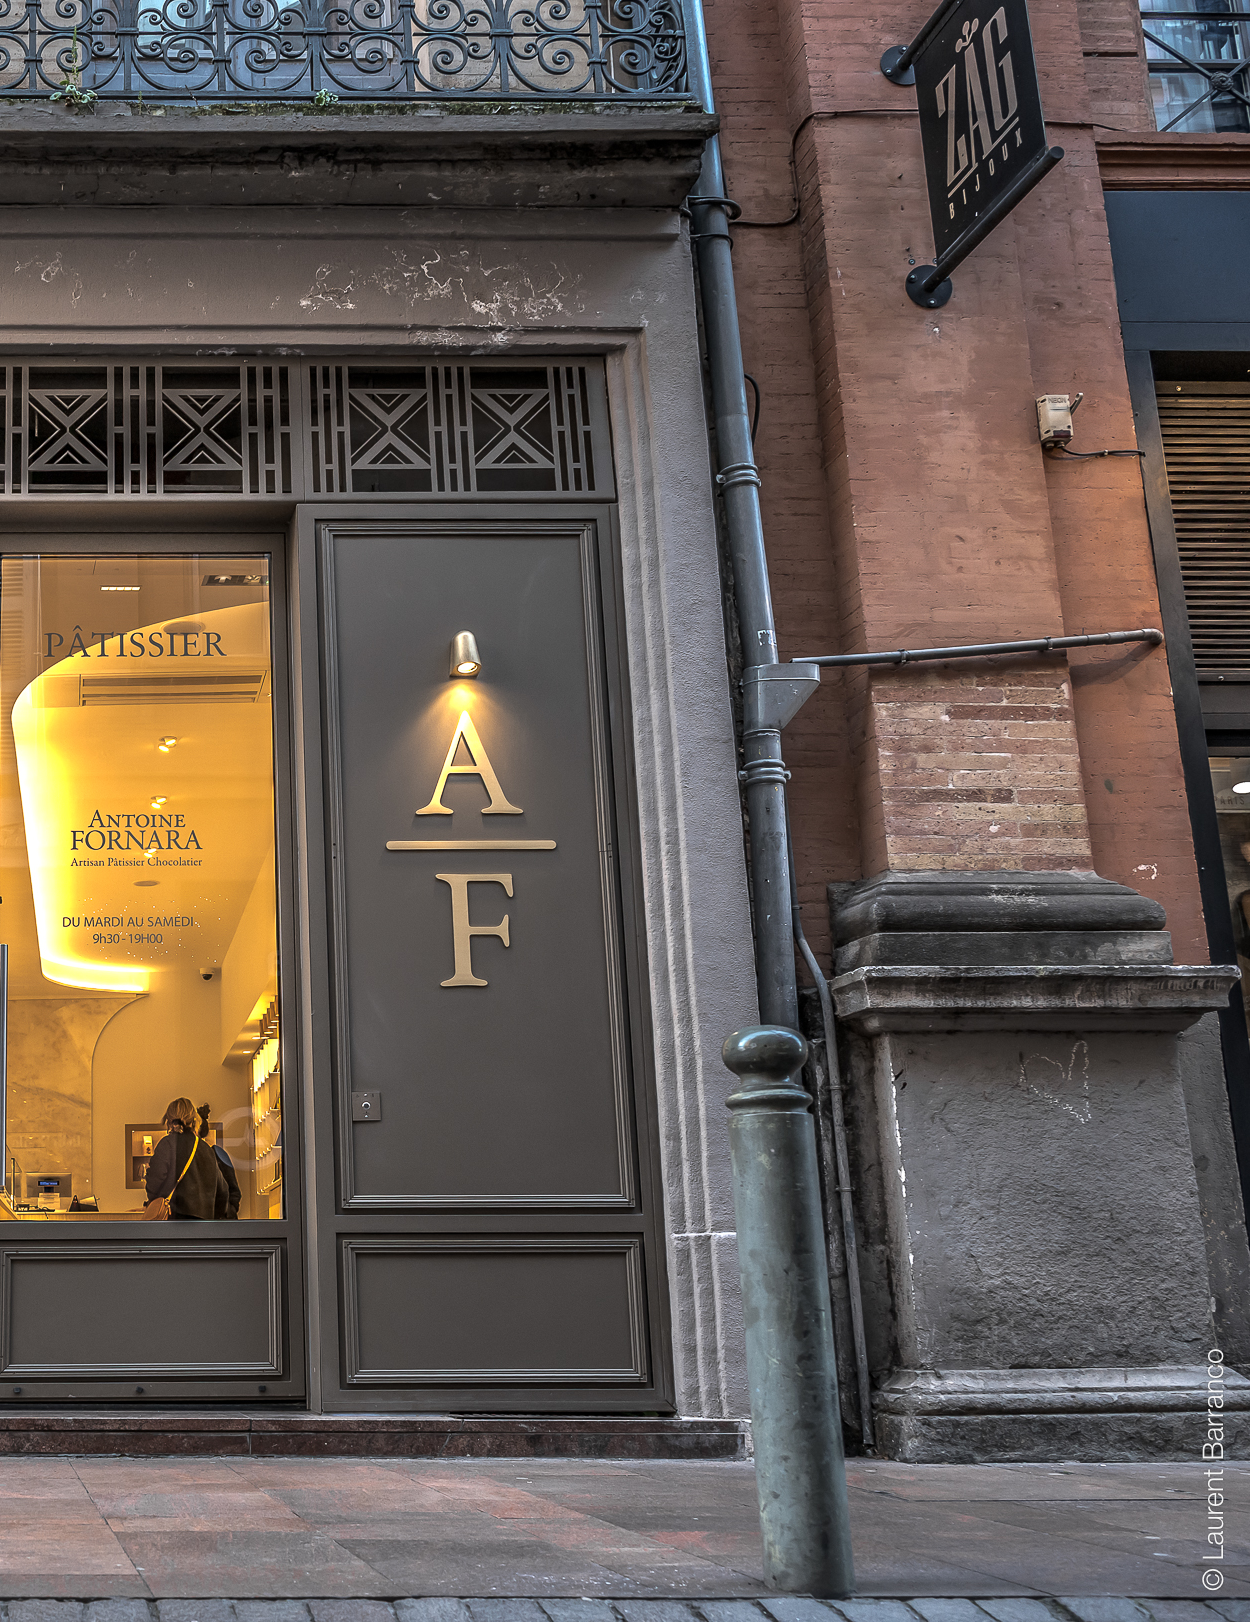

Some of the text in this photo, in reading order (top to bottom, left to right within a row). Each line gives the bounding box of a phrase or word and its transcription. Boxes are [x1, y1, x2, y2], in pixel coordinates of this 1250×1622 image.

[949, 128, 1023, 219] BIJOUX
[44, 624, 227, 659] PÂTISSIER
[415, 710, 524, 815] A
[1213, 795, 1245, 805] PARIS
[70, 830, 203, 850] FORNARA
[70, 857, 203, 867] Artisan Pâtissier Chocolatier
[62, 916, 194, 928] DU MARDI AU SAMEDI
[434, 873, 514, 987] F
[92, 933, 120, 945] 9h30
[128, 933, 163, 944] 19H00
